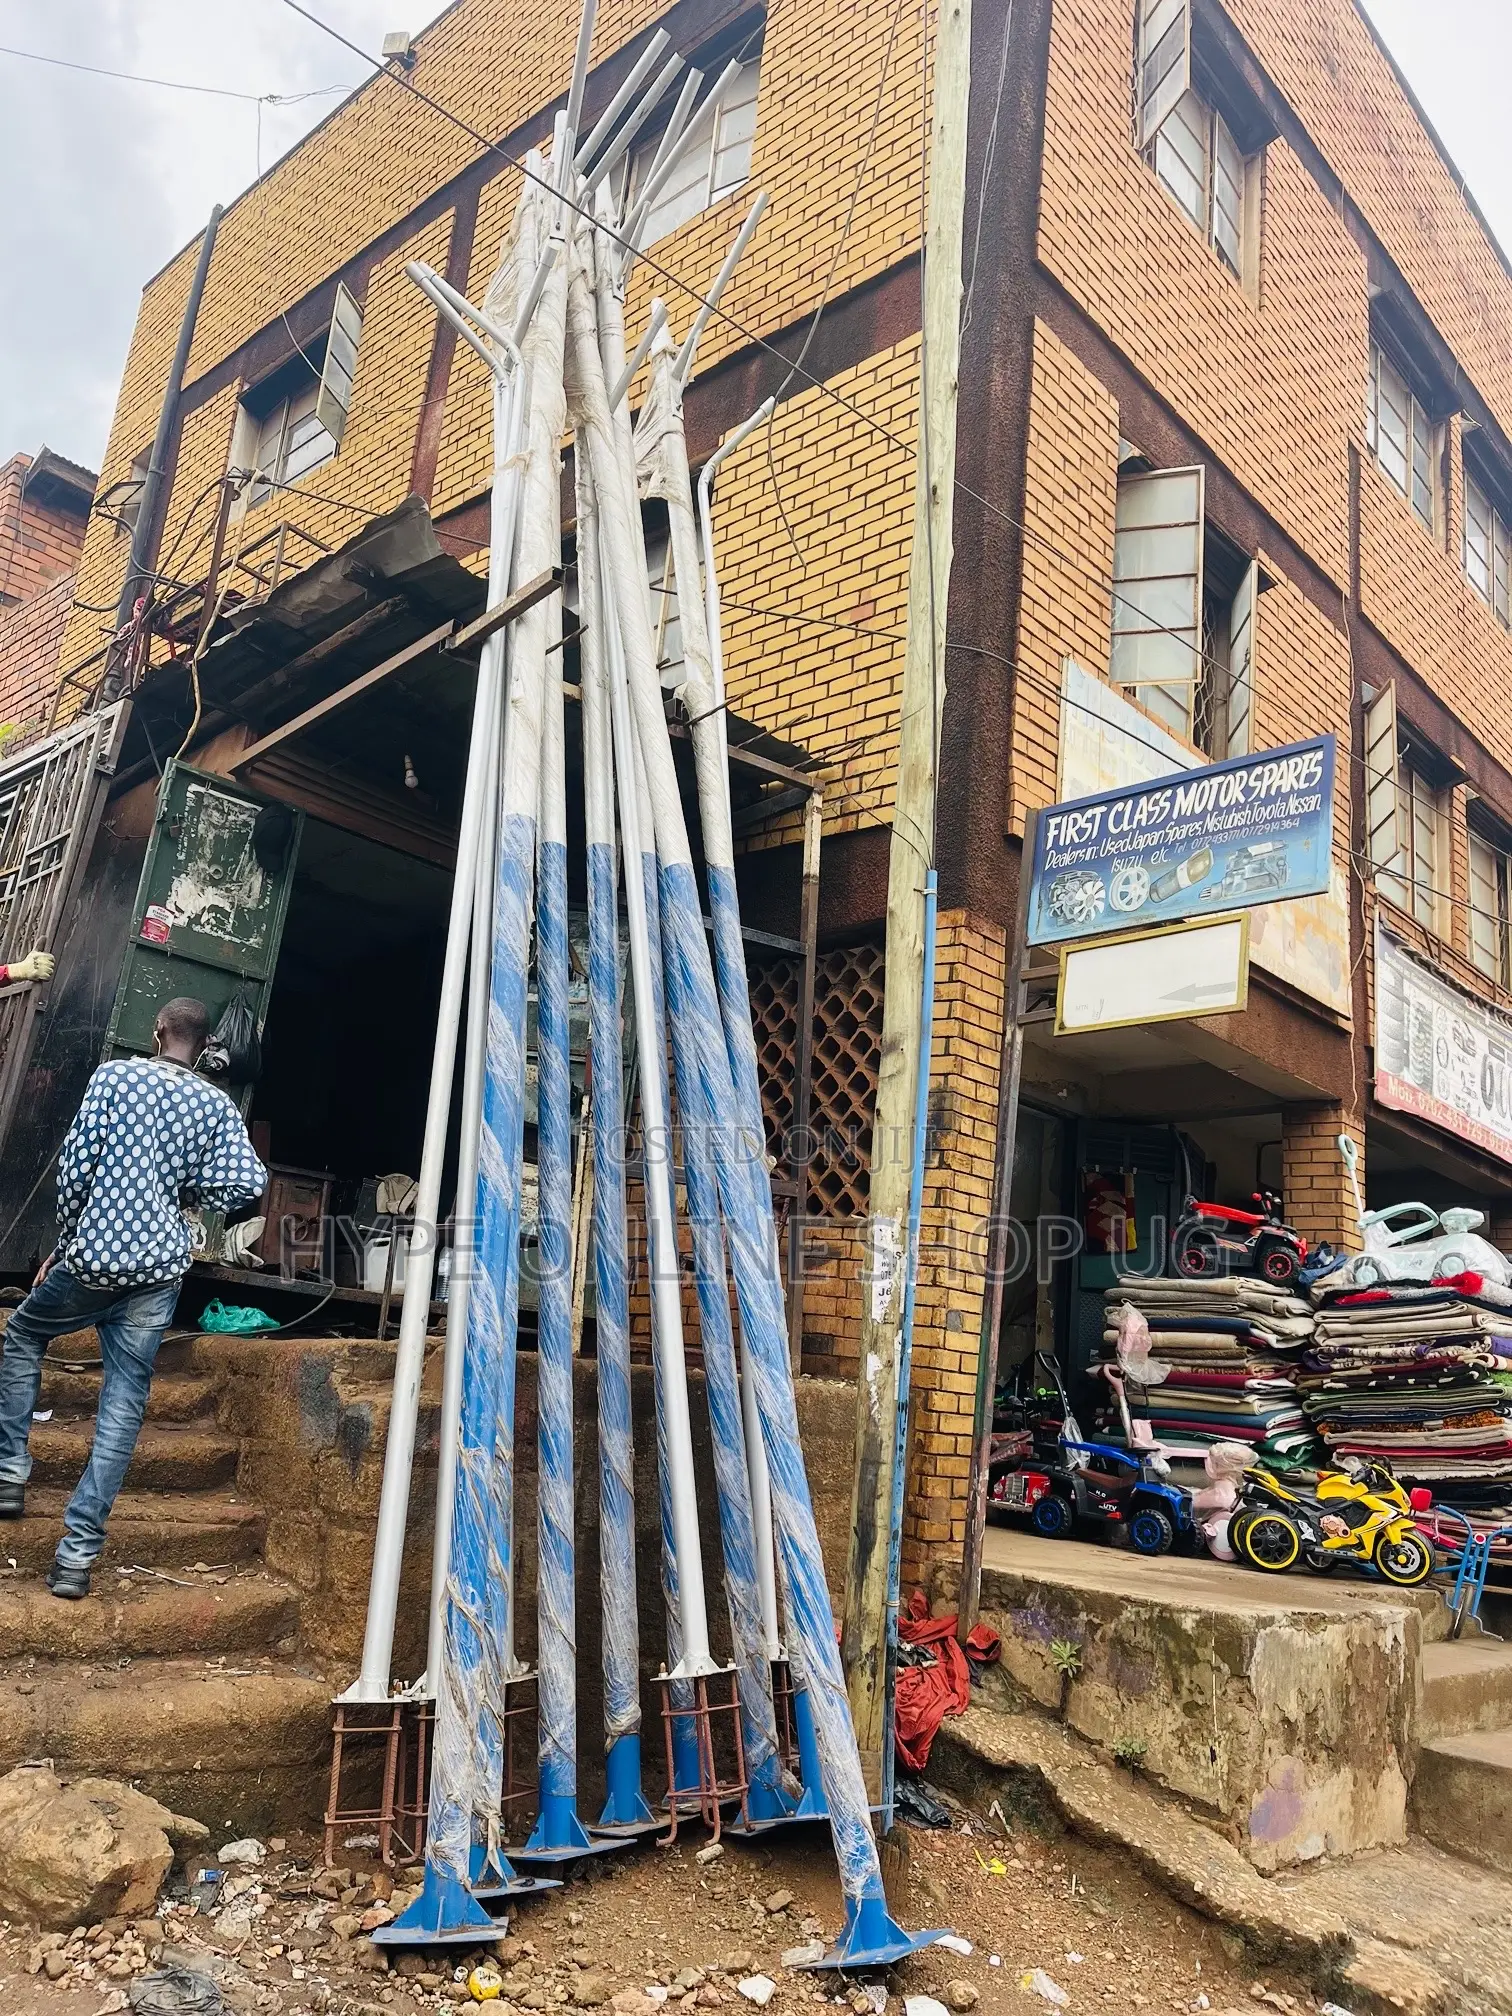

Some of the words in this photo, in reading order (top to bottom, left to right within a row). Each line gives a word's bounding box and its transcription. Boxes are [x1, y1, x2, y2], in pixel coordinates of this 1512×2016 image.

[1047, 806, 1107, 850] FIRST
[1108, 789, 1172, 834] CLASS
[1172, 770, 1248, 819] MOTOR
[1248, 751, 1324, 801] SPARES
[1129, 829, 1165, 852] Japan
[1151, 846, 1172, 865] etc.
